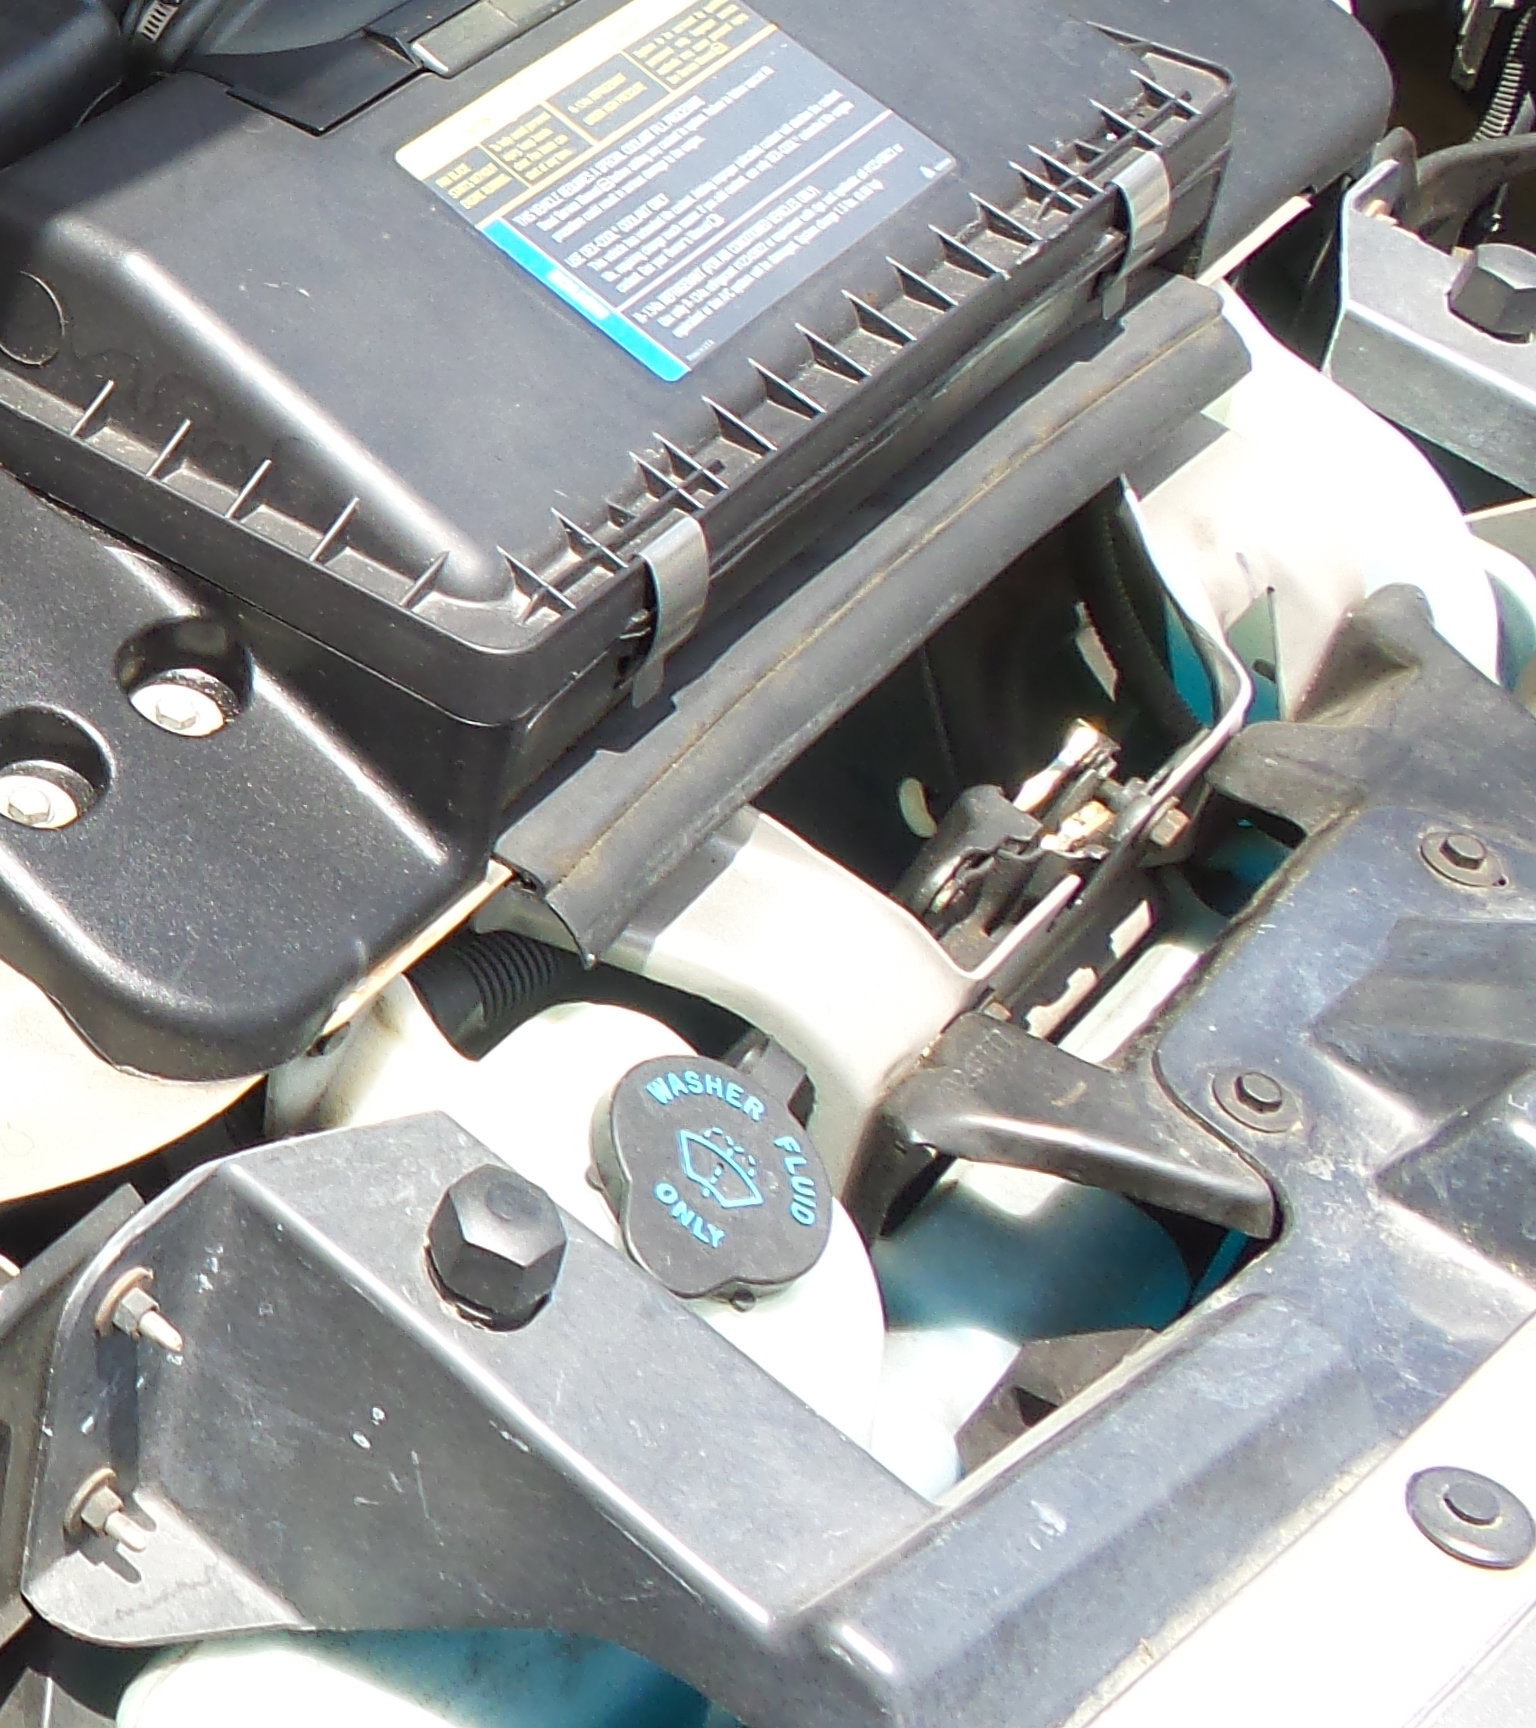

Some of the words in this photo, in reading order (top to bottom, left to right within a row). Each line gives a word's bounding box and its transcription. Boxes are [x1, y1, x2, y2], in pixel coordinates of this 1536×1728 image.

[645, 1070, 766, 1122] WASHER
[774, 1134, 818, 1226] FLUID
[653, 1182, 726, 1249] ONLY
